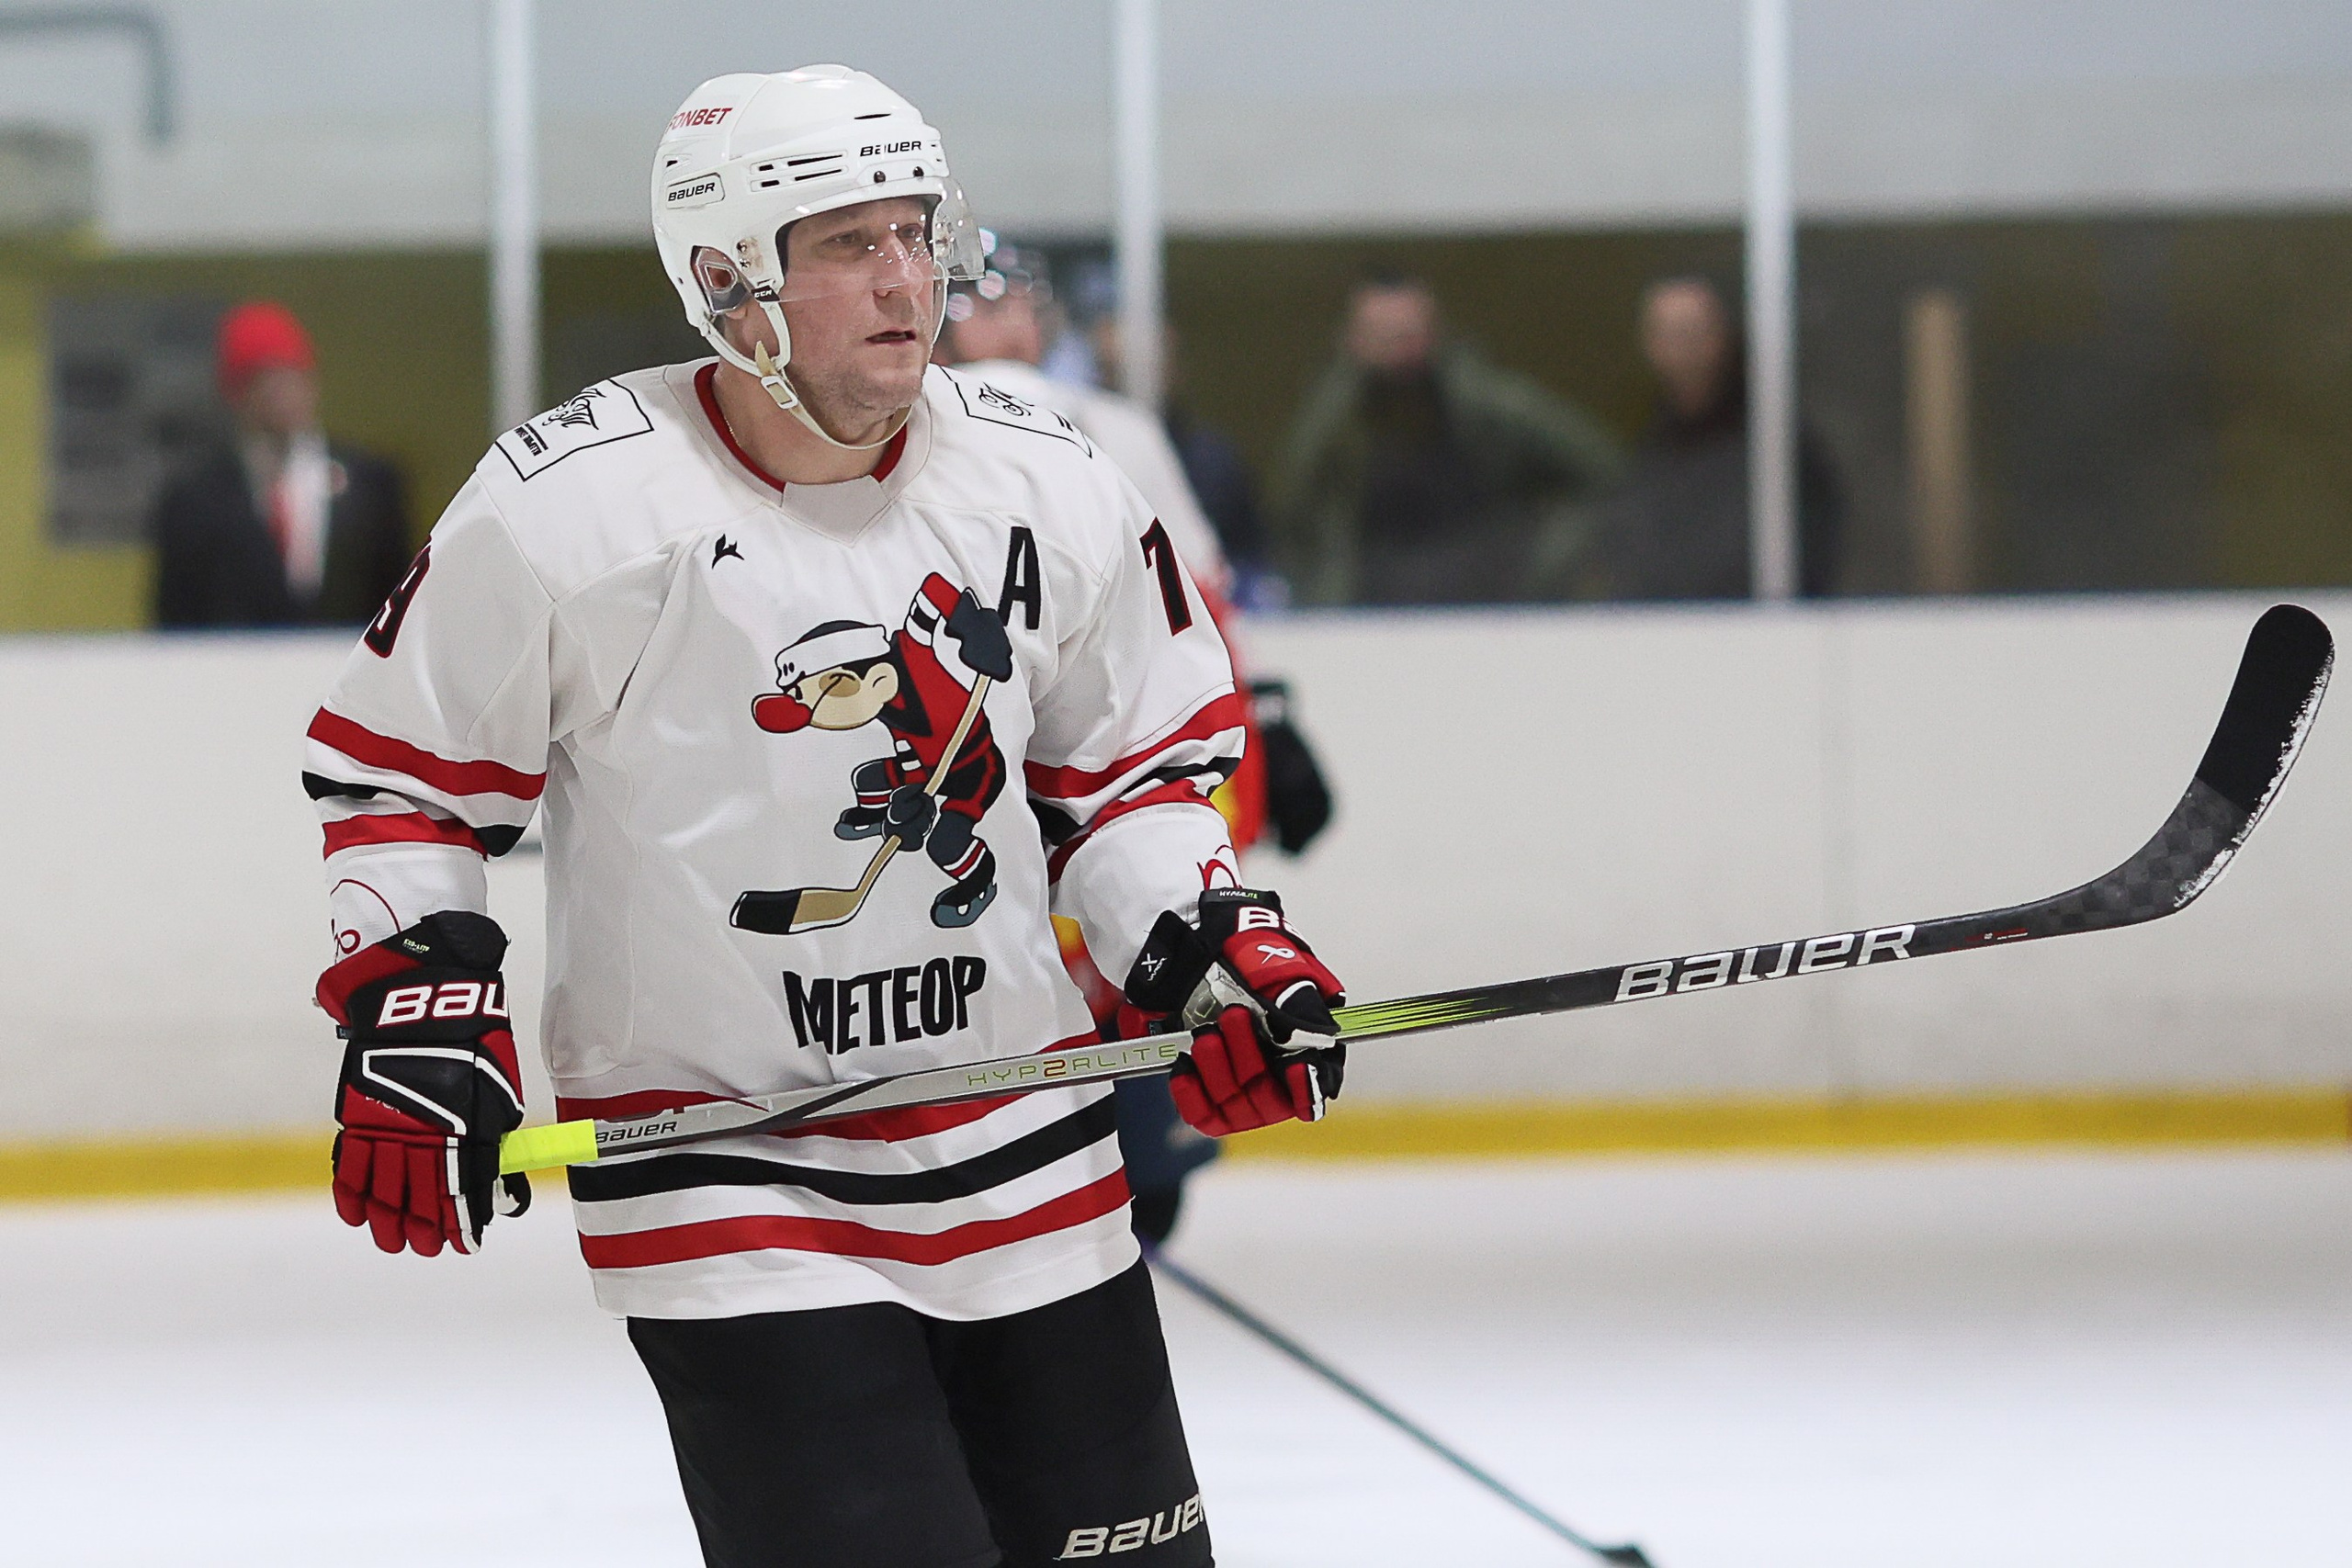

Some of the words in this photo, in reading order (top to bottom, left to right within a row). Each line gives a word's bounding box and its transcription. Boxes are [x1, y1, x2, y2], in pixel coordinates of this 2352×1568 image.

[860, 141, 922, 157] BAUER
[668, 183, 716, 202] BAUER
[998, 525, 1042, 630] A
[1614, 923, 1916, 1002] BAUER
[376, 981, 510, 1028] BAU
